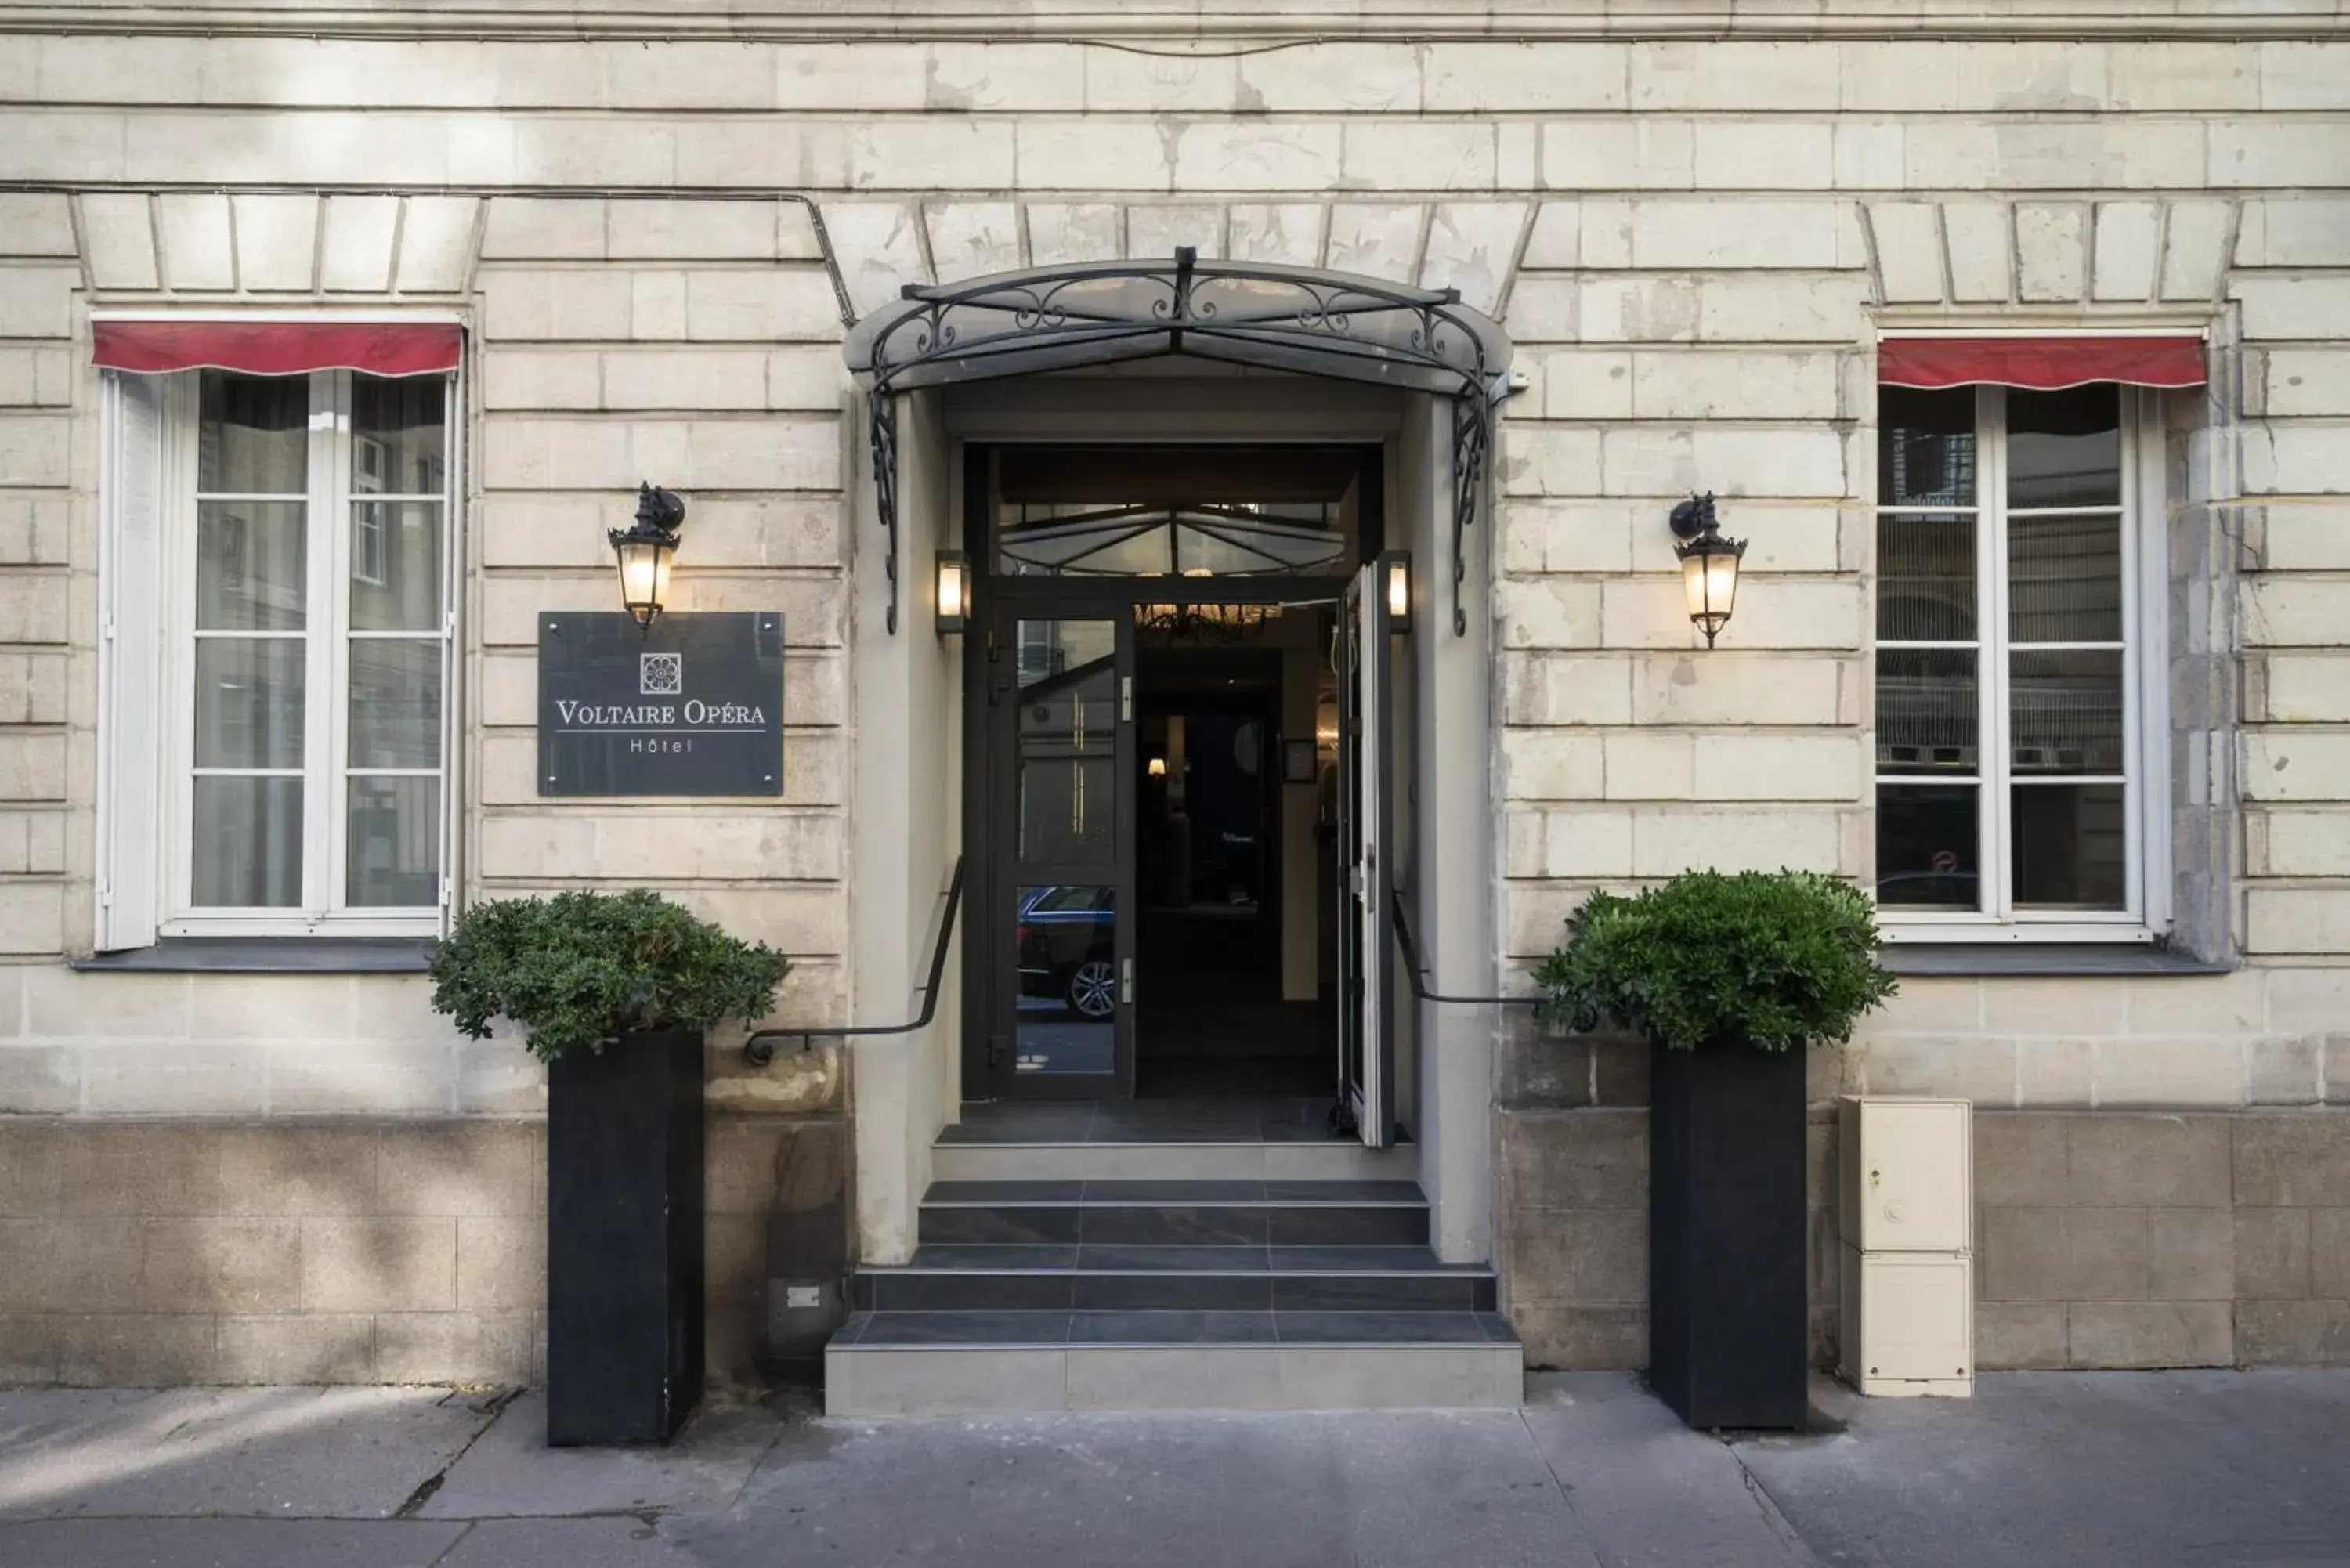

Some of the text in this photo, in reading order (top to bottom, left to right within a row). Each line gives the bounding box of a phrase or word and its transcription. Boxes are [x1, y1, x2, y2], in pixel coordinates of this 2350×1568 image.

[556, 700, 765, 724] VOLTAIRE OPÉRA
[630, 739, 692, 753] Hôtel
